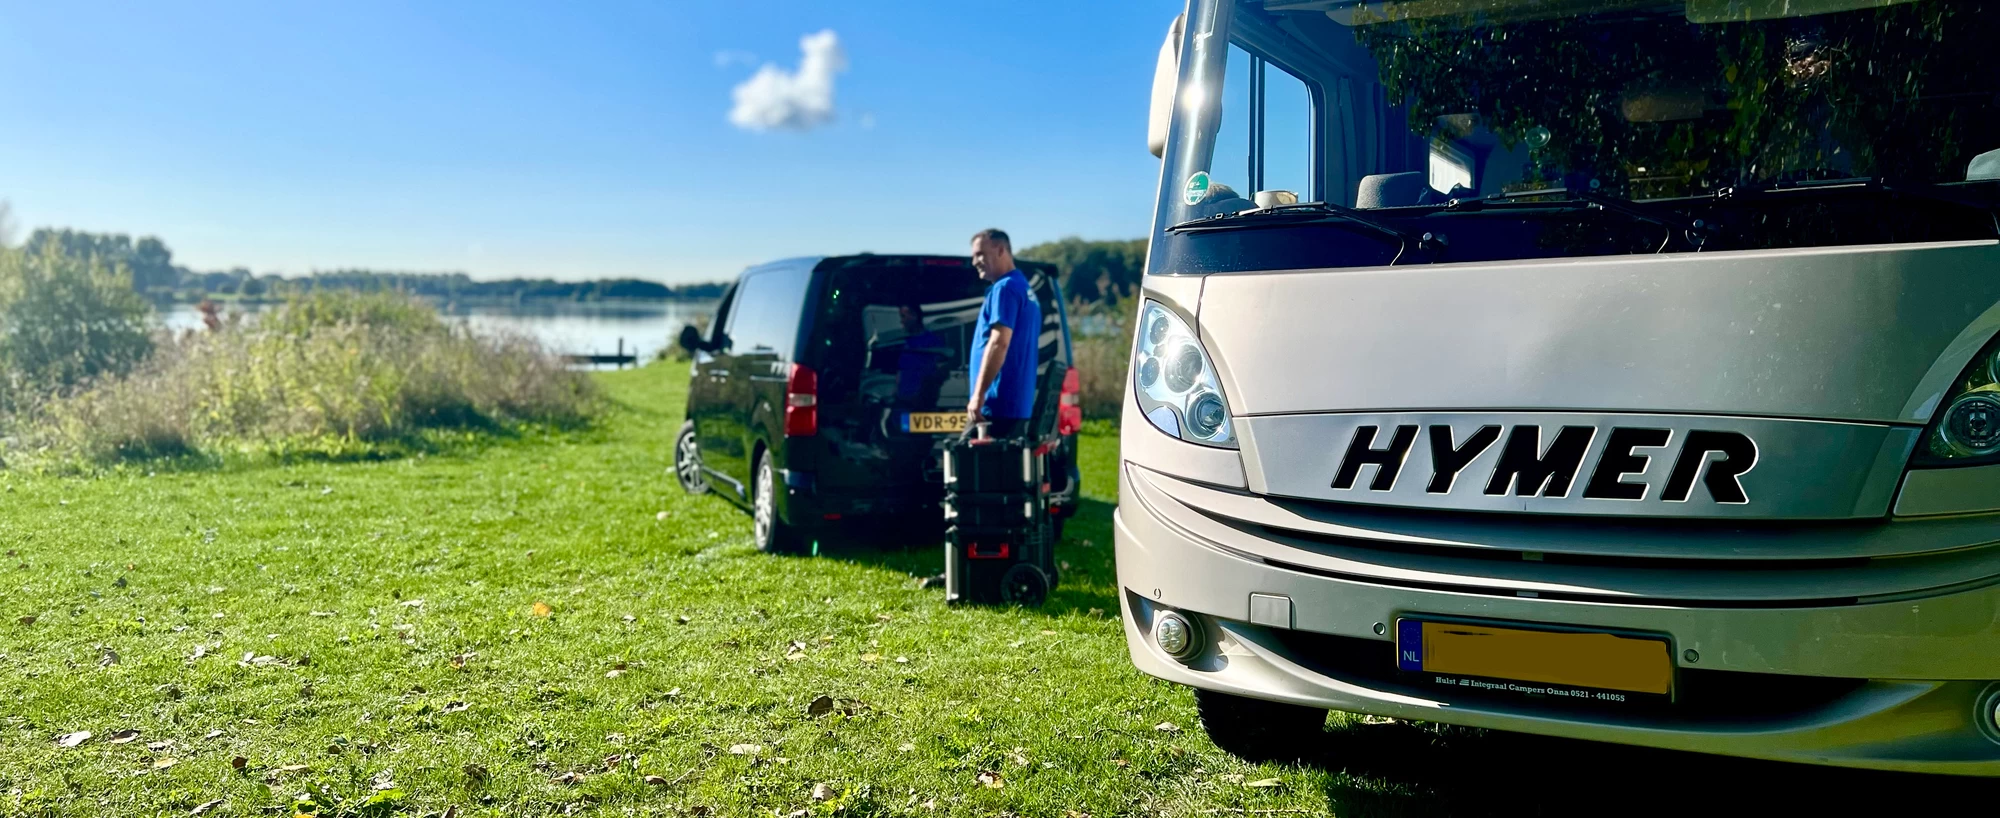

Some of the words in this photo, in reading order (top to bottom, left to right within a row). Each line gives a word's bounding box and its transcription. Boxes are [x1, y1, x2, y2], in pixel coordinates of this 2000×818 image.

[1330, 424, 1760, 505] HYMER
[1403, 650, 1420, 662] NL
[1436, 676, 1456, 685] Hulst
[1471, 680, 1507, 690] Integraal
[1508, 683, 1545, 694] Campers
[1546, 688, 1569, 697] Onna
[1570, 690, 1589, 699] 0521
